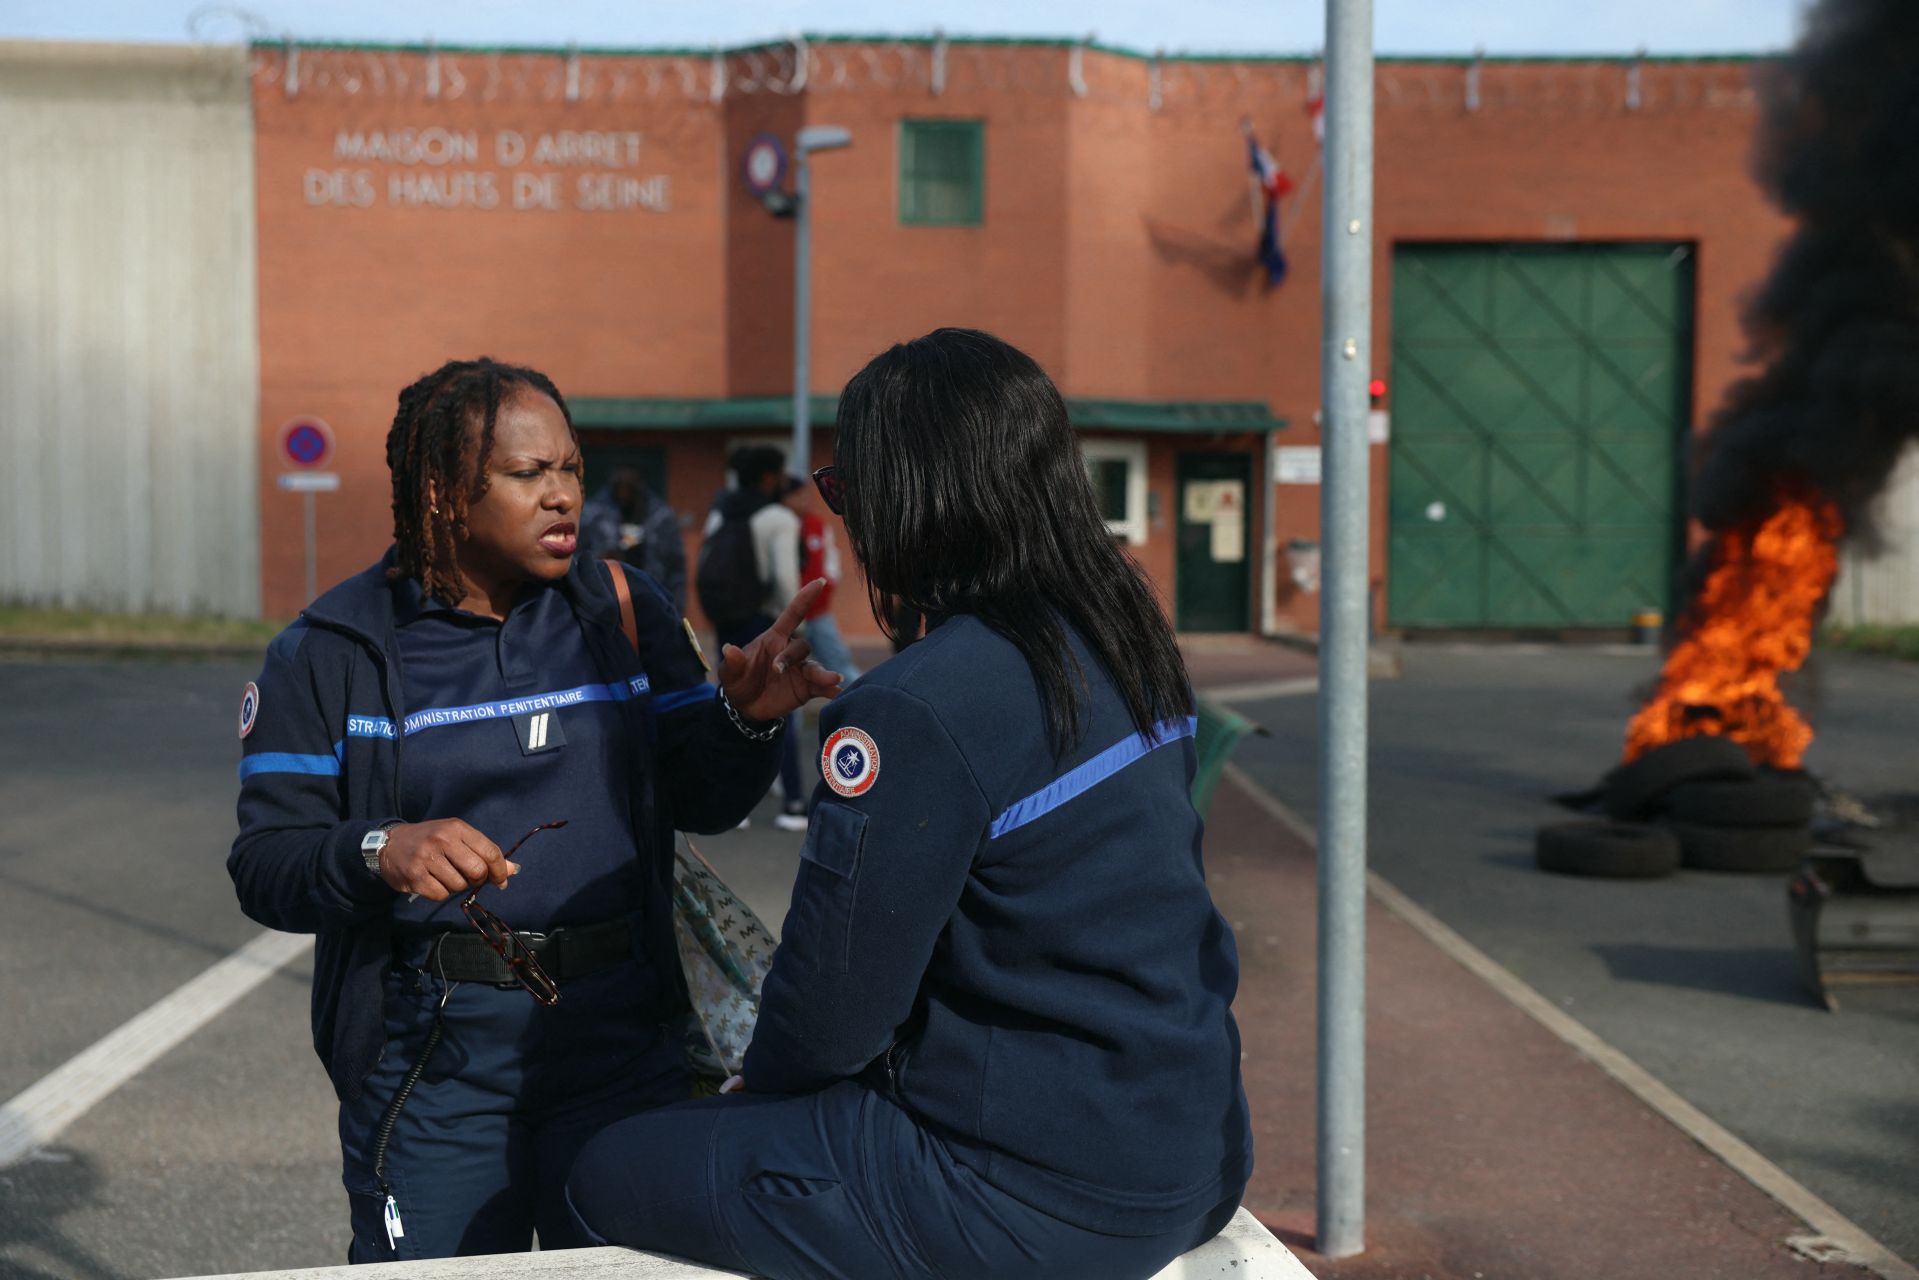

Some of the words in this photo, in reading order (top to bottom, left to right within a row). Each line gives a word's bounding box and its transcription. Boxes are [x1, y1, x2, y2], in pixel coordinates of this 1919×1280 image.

[334, 128, 478, 165] MAISON
[304, 169, 376, 208] DES
[388, 171, 499, 209] HAUTS
[512, 173, 562, 211] DE
[576, 173, 672, 213] SEINE
[500, 690, 585, 714] PENITENTIAIRE
[740, 924, 760, 939] MK
